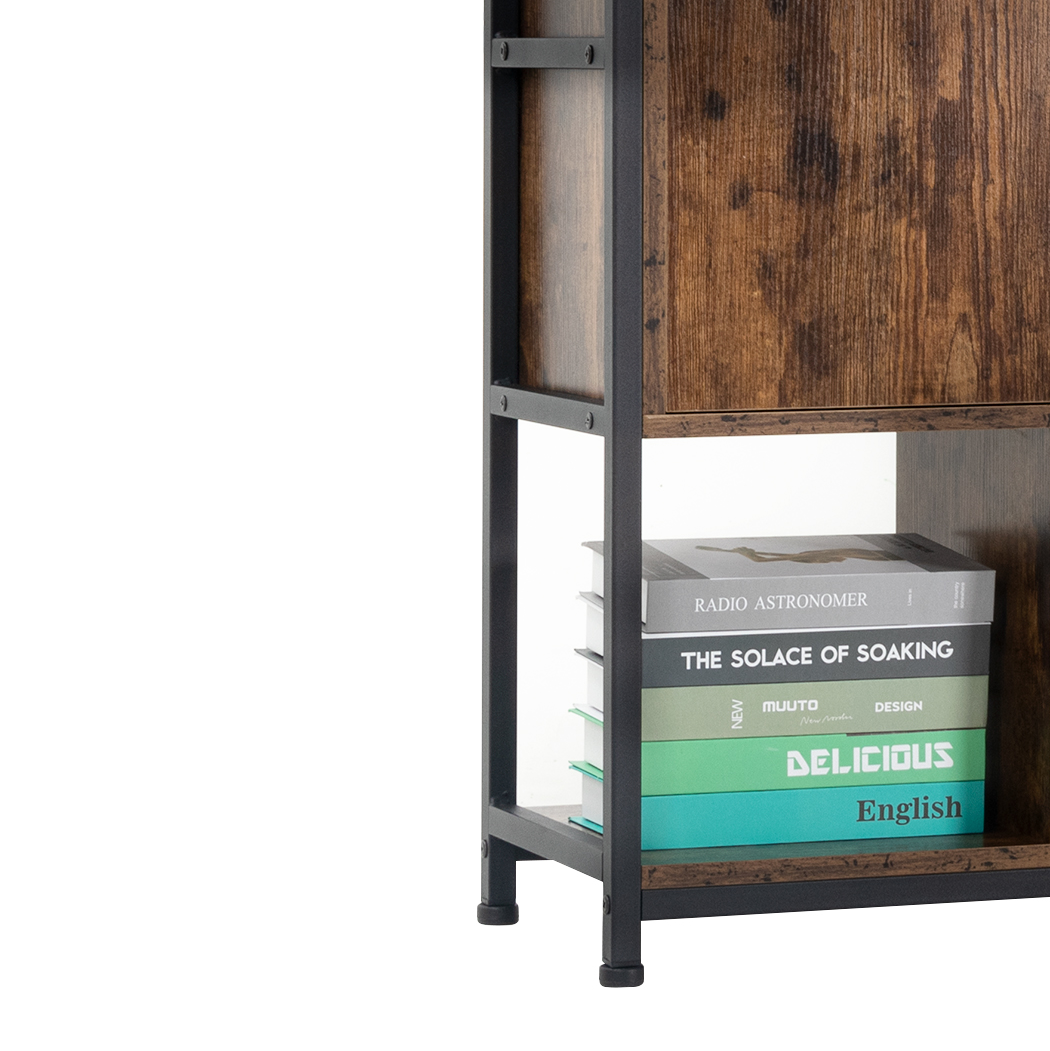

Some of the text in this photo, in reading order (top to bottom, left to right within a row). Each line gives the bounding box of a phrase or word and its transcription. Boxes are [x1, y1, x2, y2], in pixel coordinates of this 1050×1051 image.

[694, 592, 868, 613] RADIO ASTRONOMER
[681, 640, 954, 670] THE SOLACE OF SOAKING
[731, 699, 743, 730] NEW
[875, 700, 923, 713] DESIGN
[787, 741, 954, 777] DELICIOUS
[856, 795, 963, 826] English
